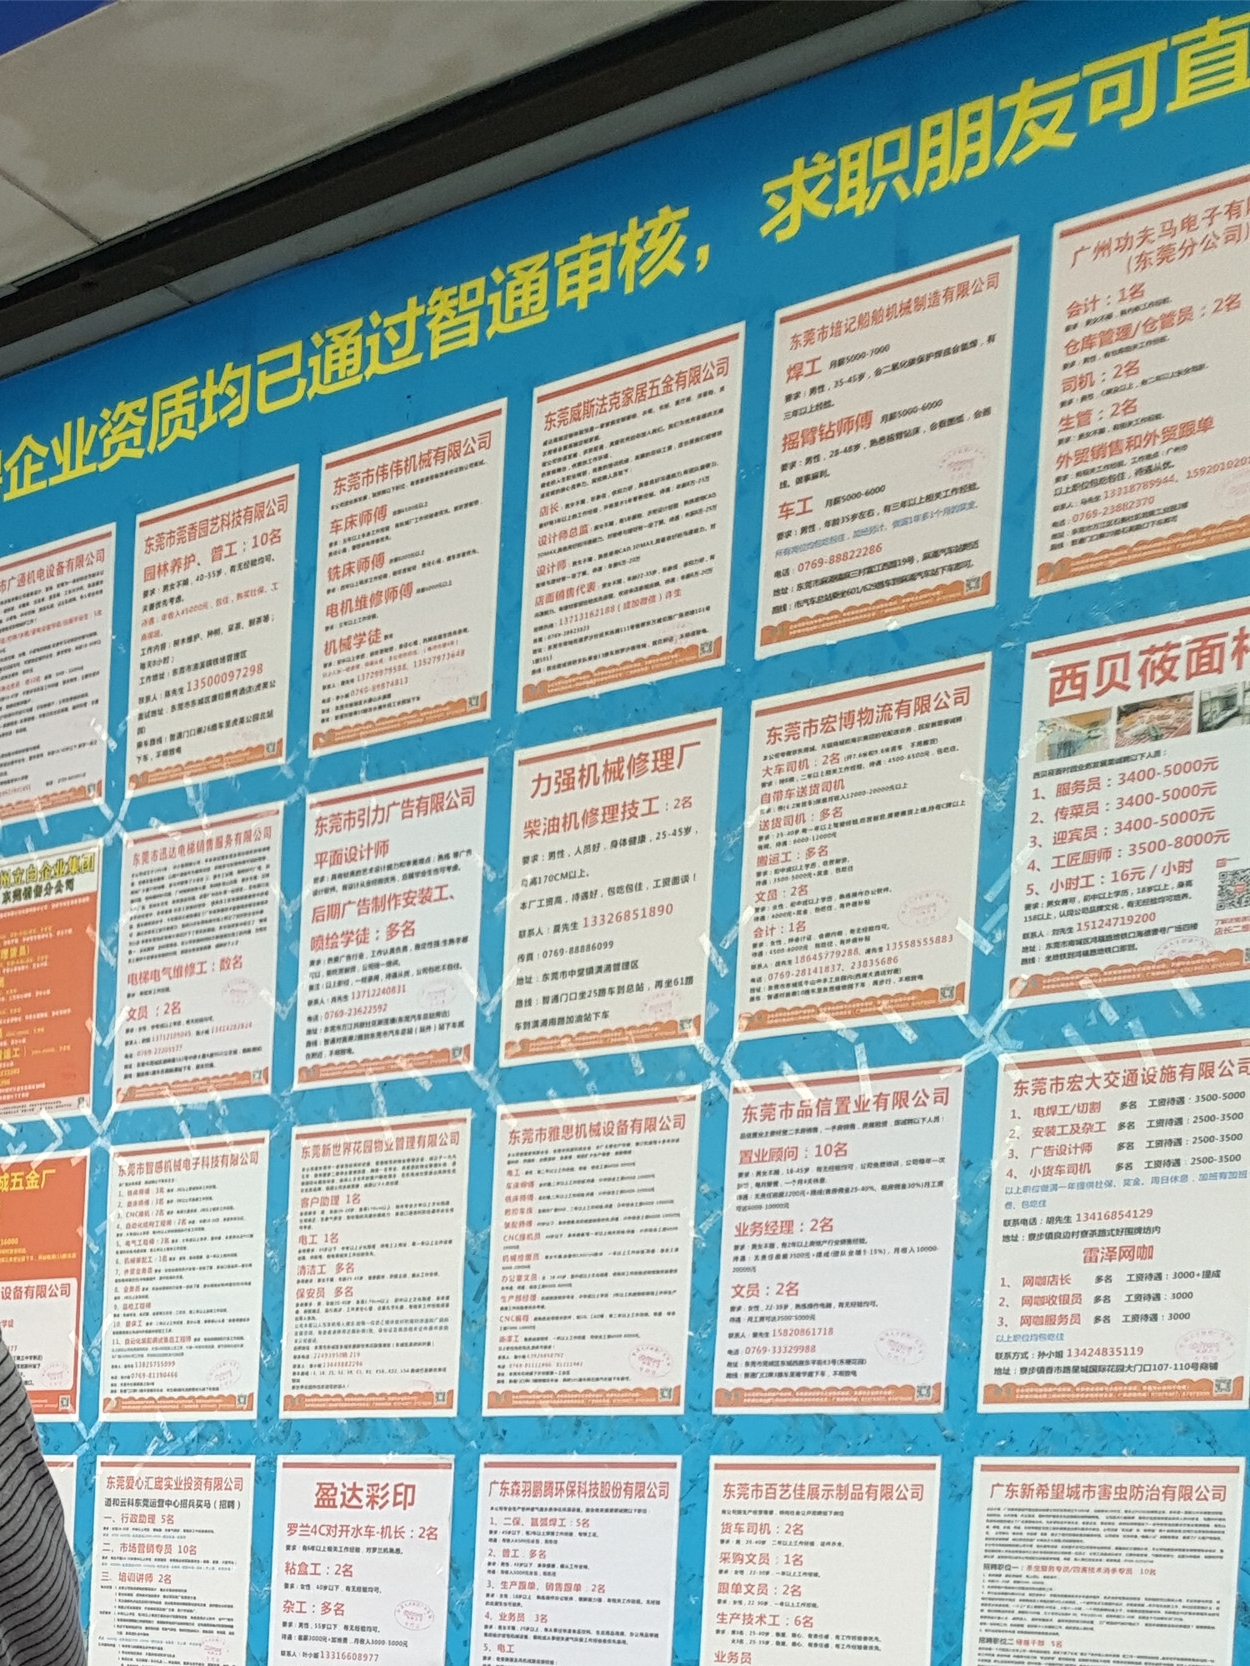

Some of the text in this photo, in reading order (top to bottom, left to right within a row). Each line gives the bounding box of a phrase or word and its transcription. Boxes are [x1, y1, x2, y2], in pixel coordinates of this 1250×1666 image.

[759, 10, 1250, 243] 求职朋友可直
[786, 357, 823, 384] 焊工
[1061, 359, 1141, 394] 司机：2名
[543, 355, 730, 432] 东莞威斯法克家居五金有限公司
[1058, 397, 1138, 432] 生管：2名
[781, 410, 874, 453] 摇臂钻师傅
[333, 430, 492, 496] 东莞市伟伟机械有限公司
[329, 504, 388, 536] 车床师傅
[777, 496, 814, 522] 车工
[327, 551, 385, 583] 铣床师傅
[326, 581, 413, 620] 电机维修师傅
[324, 627, 383, 657] 机械学徒
[765, 685, 971, 746] 东莞市宏博物流有限公司
[530, 741, 701, 800] 力强机械修理厂
[761, 752, 841, 779] 大车司机：2名
[314, 786, 475, 837] 东莞市引力广告有限公司
[523, 795, 693, 840] 柴油机修理技工：2名
[758, 806, 844, 832] 送货司机：多名
[314, 839, 390, 869] 平面设计师
[756, 844, 829, 868] 搬运工：多名
[755, 884, 809, 903] 文员：2名
[582, 902, 674, 930] 13326851890
[753, 920, 807, 939] 会计：1名
[1012, 1056, 1250, 1098] 东莞市宏大交通设施有限公司
[741, 1086, 950, 1124] 东莞市品信置业有限公司
[1119, 1099, 1138, 1112] 多名
[508, 1113, 686, 1146] 东莞市雅思机械设备有限公司
[1117, 1120, 1136, 1132] 多名
[1116, 1140, 1135, 1152] 多名
[1115, 1161, 1134, 1173] 多名
[734, 1216, 834, 1238] 业务经理：2名
[1075, 1207, 1154, 1223] 13416854129
[298, 1233, 318, 1246] 电工
[1082, 1244, 1155, 1265] 雷泽网咖
[297, 1262, 355, 1277] 清洁工 多名
[295, 1286, 354, 1300] 保安员 多名
[730, 1281, 800, 1299] 文员：2名
[313, 1481, 417, 1511] 盈达彩印
[722, 1482, 925, 1502] 东莞市百艺佳展示制品有限公司
[989, 1482, 1227, 1503] 广东新希望城市害虫防治有限公司
[720, 1521, 804, 1536] 货车司机：2名
[282, 1600, 346, 1617] 杂工：多名
[716, 1612, 814, 1629] 生产技术工：6名
[714, 1650, 752, 1665] 业务员
